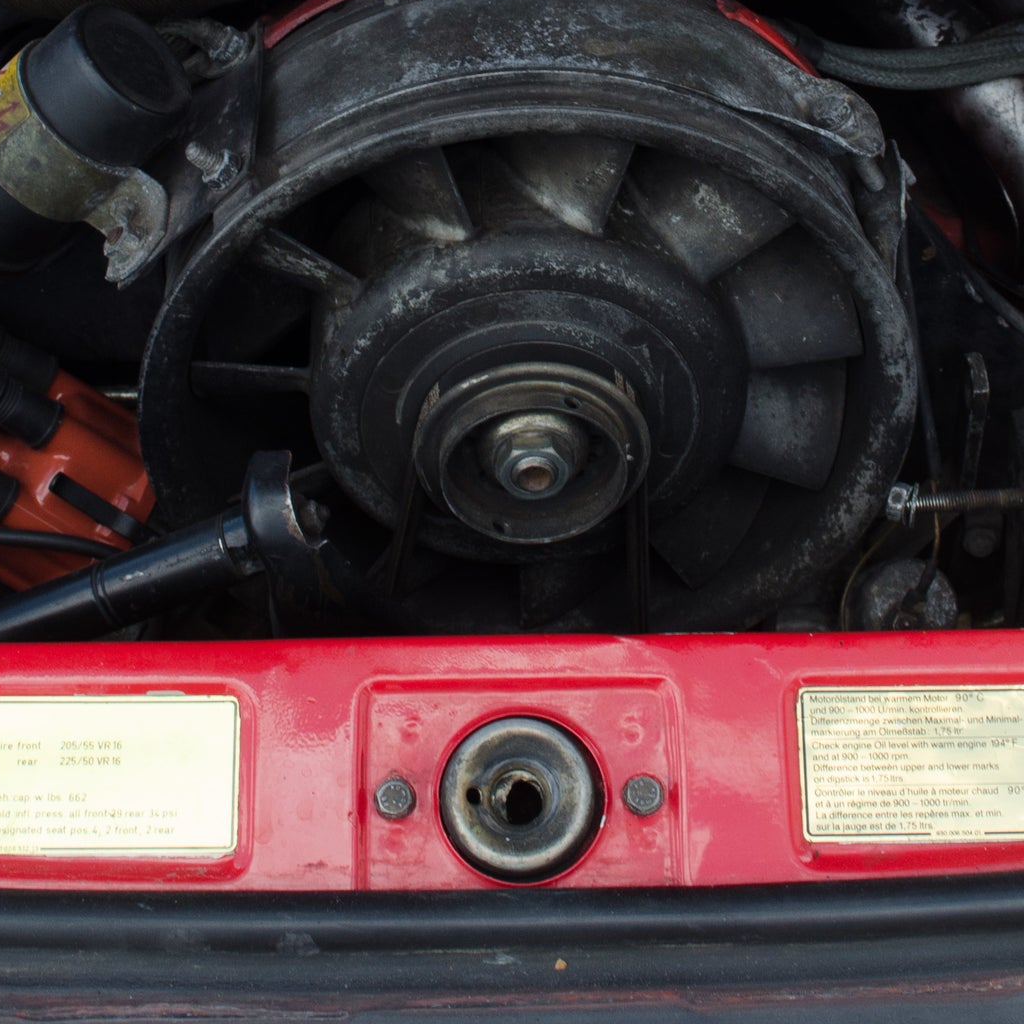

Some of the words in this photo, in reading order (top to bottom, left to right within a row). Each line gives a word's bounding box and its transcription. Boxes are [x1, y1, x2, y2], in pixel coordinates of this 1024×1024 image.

[809, 695, 866, 704] Motorölstand
[884, 695, 921, 703] warmem
[977, 693, 984, 702] C
[810, 706, 827, 714] und
[828, 706, 845, 714] 900
[855, 706, 876, 714] 1000
[810, 717, 880, 726] Differenzmenge
[882, 716, 923, 724] zwischen
[967, 716, 984, 724] und
[986, 715, 1023, 724] Minimal-
[811, 728, 860, 737] markierung
[863, 728, 877, 736] am
[934, 728, 952, 737] 1,75
[17, 741, 42, 750] front
[60, 741, 95, 750] 205/55
[97, 741, 111, 750] VR
[113, 741, 122, 750] 16
[812, 741, 839, 750] Check
[842, 741, 871, 751] engine
[874, 740, 886, 749] Oil
[889, 741, 909, 749] level
[911, 740, 929, 749] with
[930, 741, 955, 749] warm
[957, 740, 987, 750] engine
[17, 757, 38, 766] rear
[59, 756, 95, 766] 225/50
[96, 757, 110, 766] VR
[111, 756, 121, 766] 16
[813, 753, 829, 761] and
[831, 753, 840, 761] at
[868, 752, 889, 760] 1000
[813, 763, 858, 772] Difference
[860, 763, 898, 772] between
[900, 763, 925, 773] upper
[928, 763, 945, 771] and
[946, 763, 970, 771] lower
[813, 776, 825, 784] on
[827, 775, 860, 785] dipstick
[862, 775, 869, 783] is
[814, 786, 855, 796] Contrôler
[857, 787, 865, 795] le
[868, 787, 897, 795] niveau
[939, 787, 969, 795] moteur
[971, 786, 999, 795] chaud
[68, 793, 87, 802] 662
[879, 799, 891, 807] de
[893, 799, 910, 807] 900
[920, 799, 941, 807] 1000
[124, 810, 145, 818] rear
[816, 811, 825, 819] La
[876, 811, 897, 819] entre
[900, 810, 913, 819] les
[975, 810, 986, 818] et
[46, 826, 66, 835] seat
[154, 827, 175, 835] rear
[816, 822, 830, 831] sur
[832, 822, 841, 830] la
[842, 821, 867, 832] jauge
[869, 822, 884, 830] est
[886, 821, 897, 830] de
[899, 821, 917, 831] 1,75
